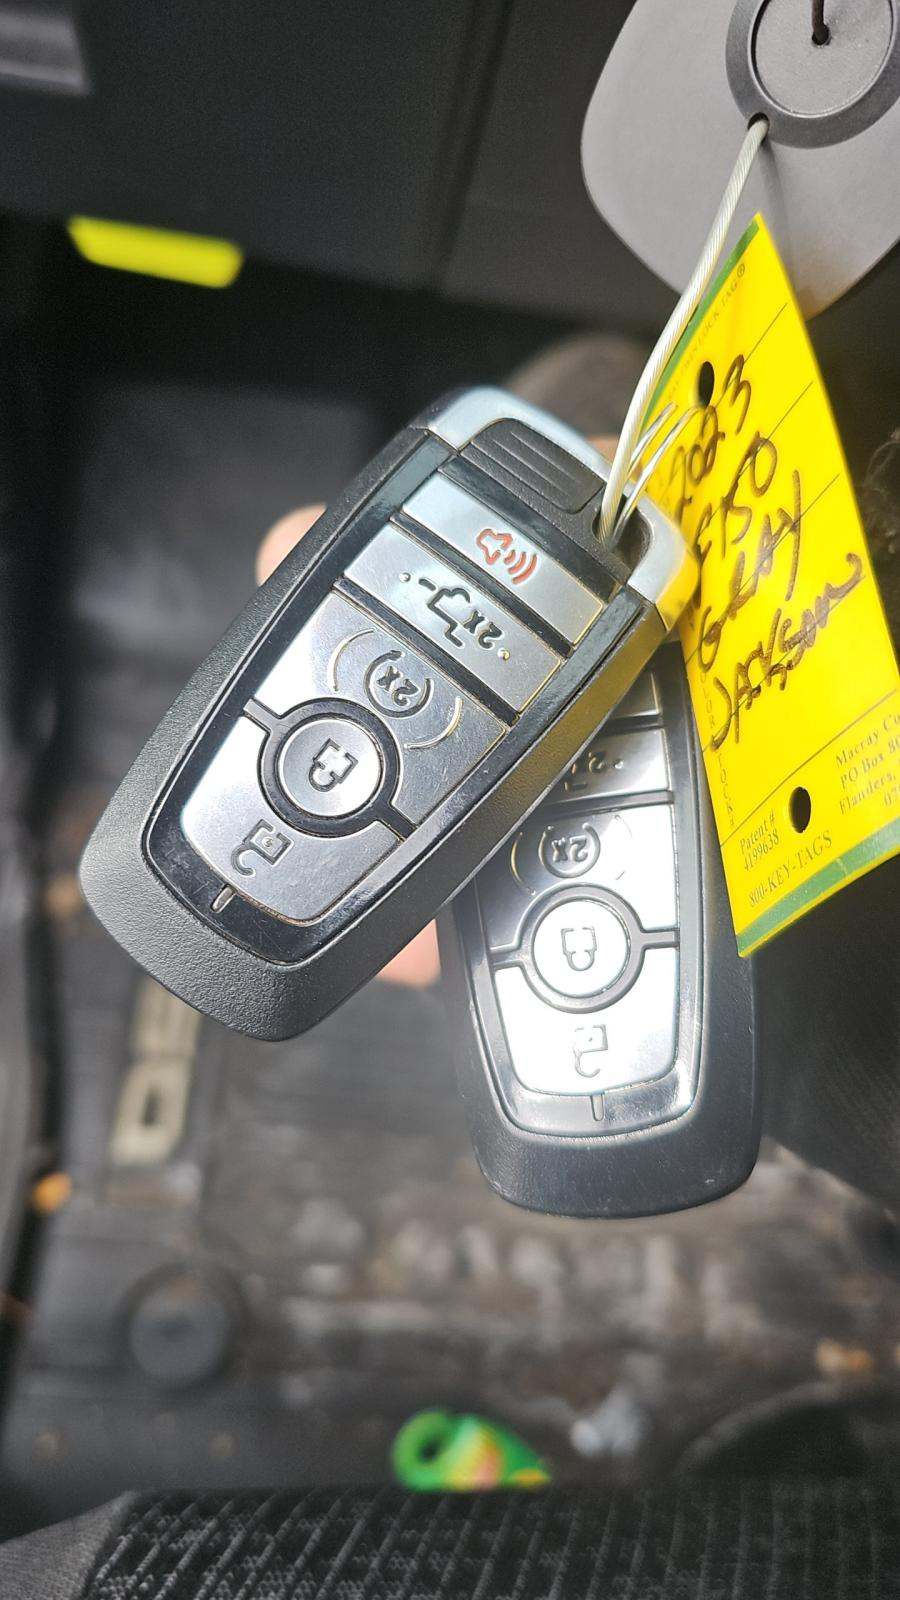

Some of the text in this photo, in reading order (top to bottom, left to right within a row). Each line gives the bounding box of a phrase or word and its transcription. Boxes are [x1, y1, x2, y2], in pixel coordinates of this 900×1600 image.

[836, 728, 879, 769] Macray
[740, 819, 768, 854] Patent
[744, 828, 780, 871] 4199638
[748, 830, 832, 908] 800-KEY-TAGS
